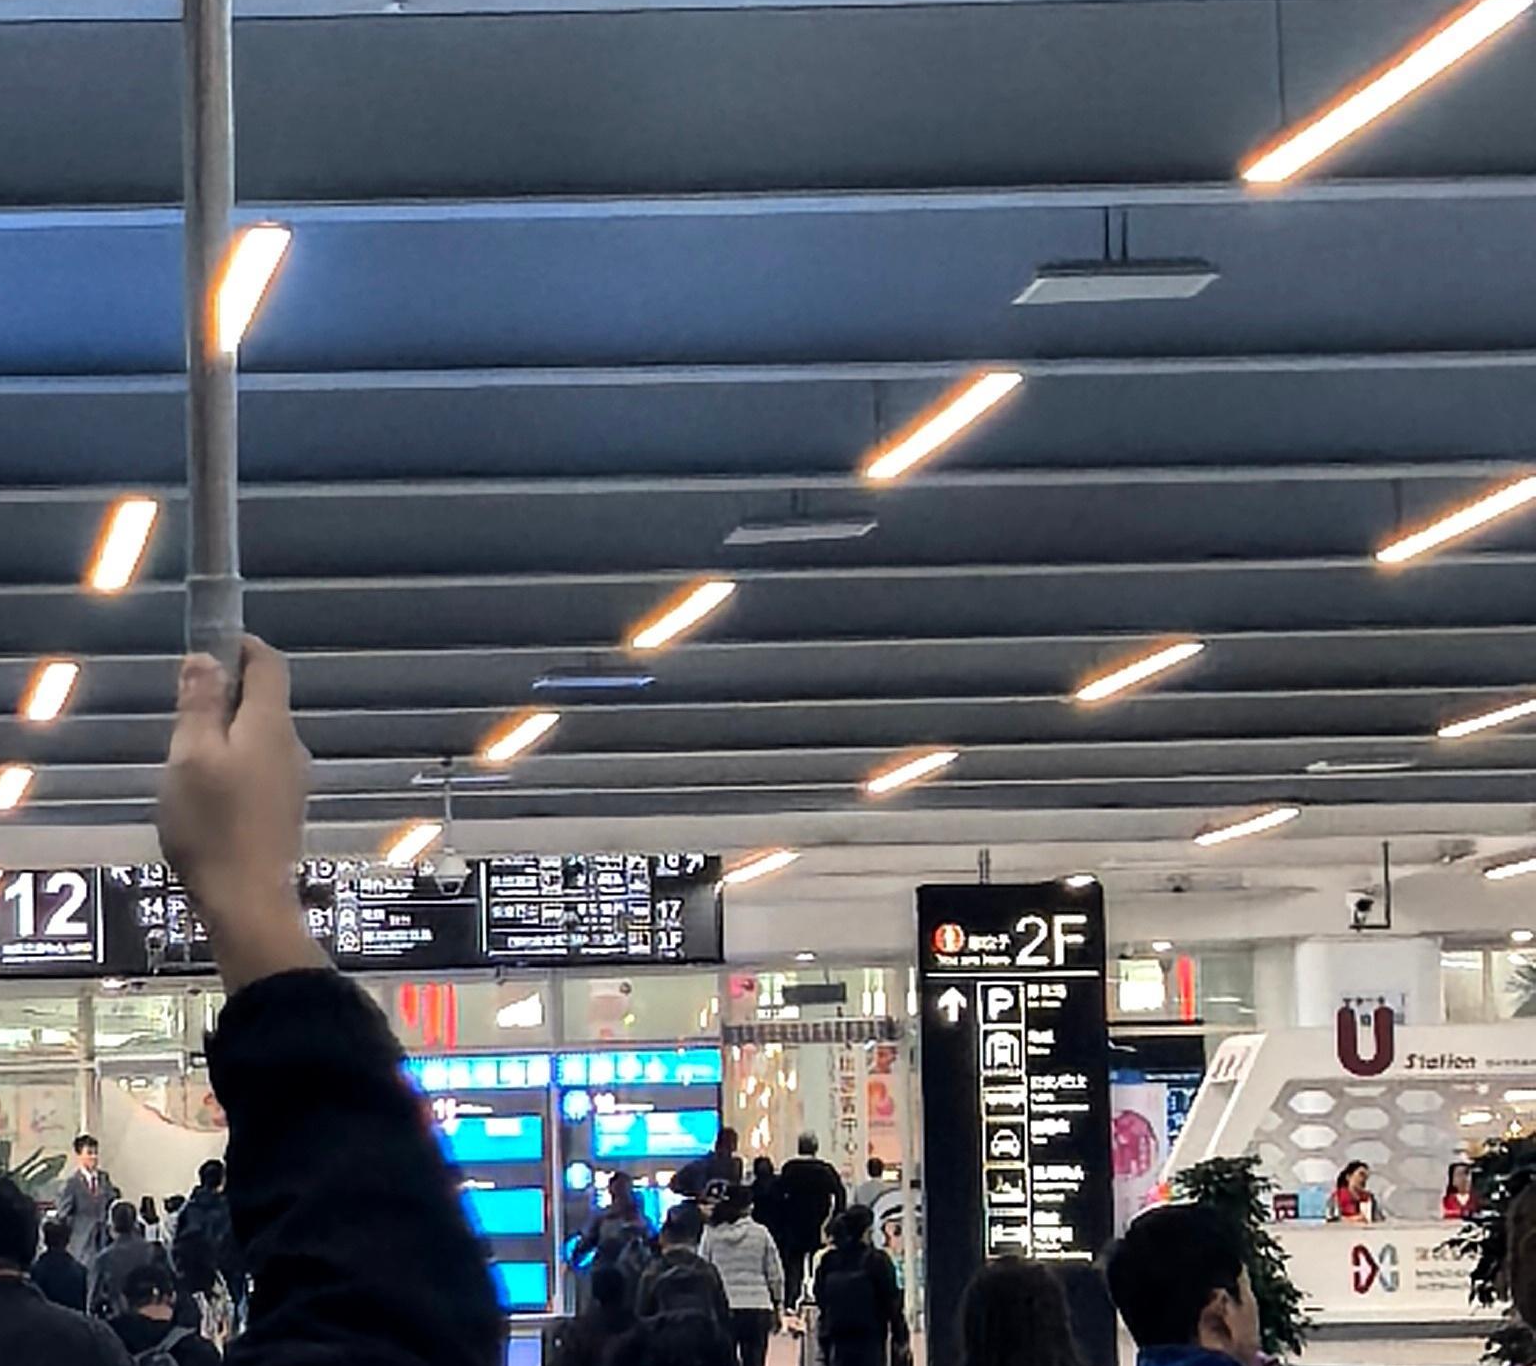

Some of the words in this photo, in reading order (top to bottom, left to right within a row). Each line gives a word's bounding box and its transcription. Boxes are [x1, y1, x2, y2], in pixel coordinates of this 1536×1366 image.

[4, 871, 88, 937] 12
[1016, 915, 1087, 966] 2F
[1337, 1006, 1394, 1077] U
[1404, 1053, 1476, 1070] Station
